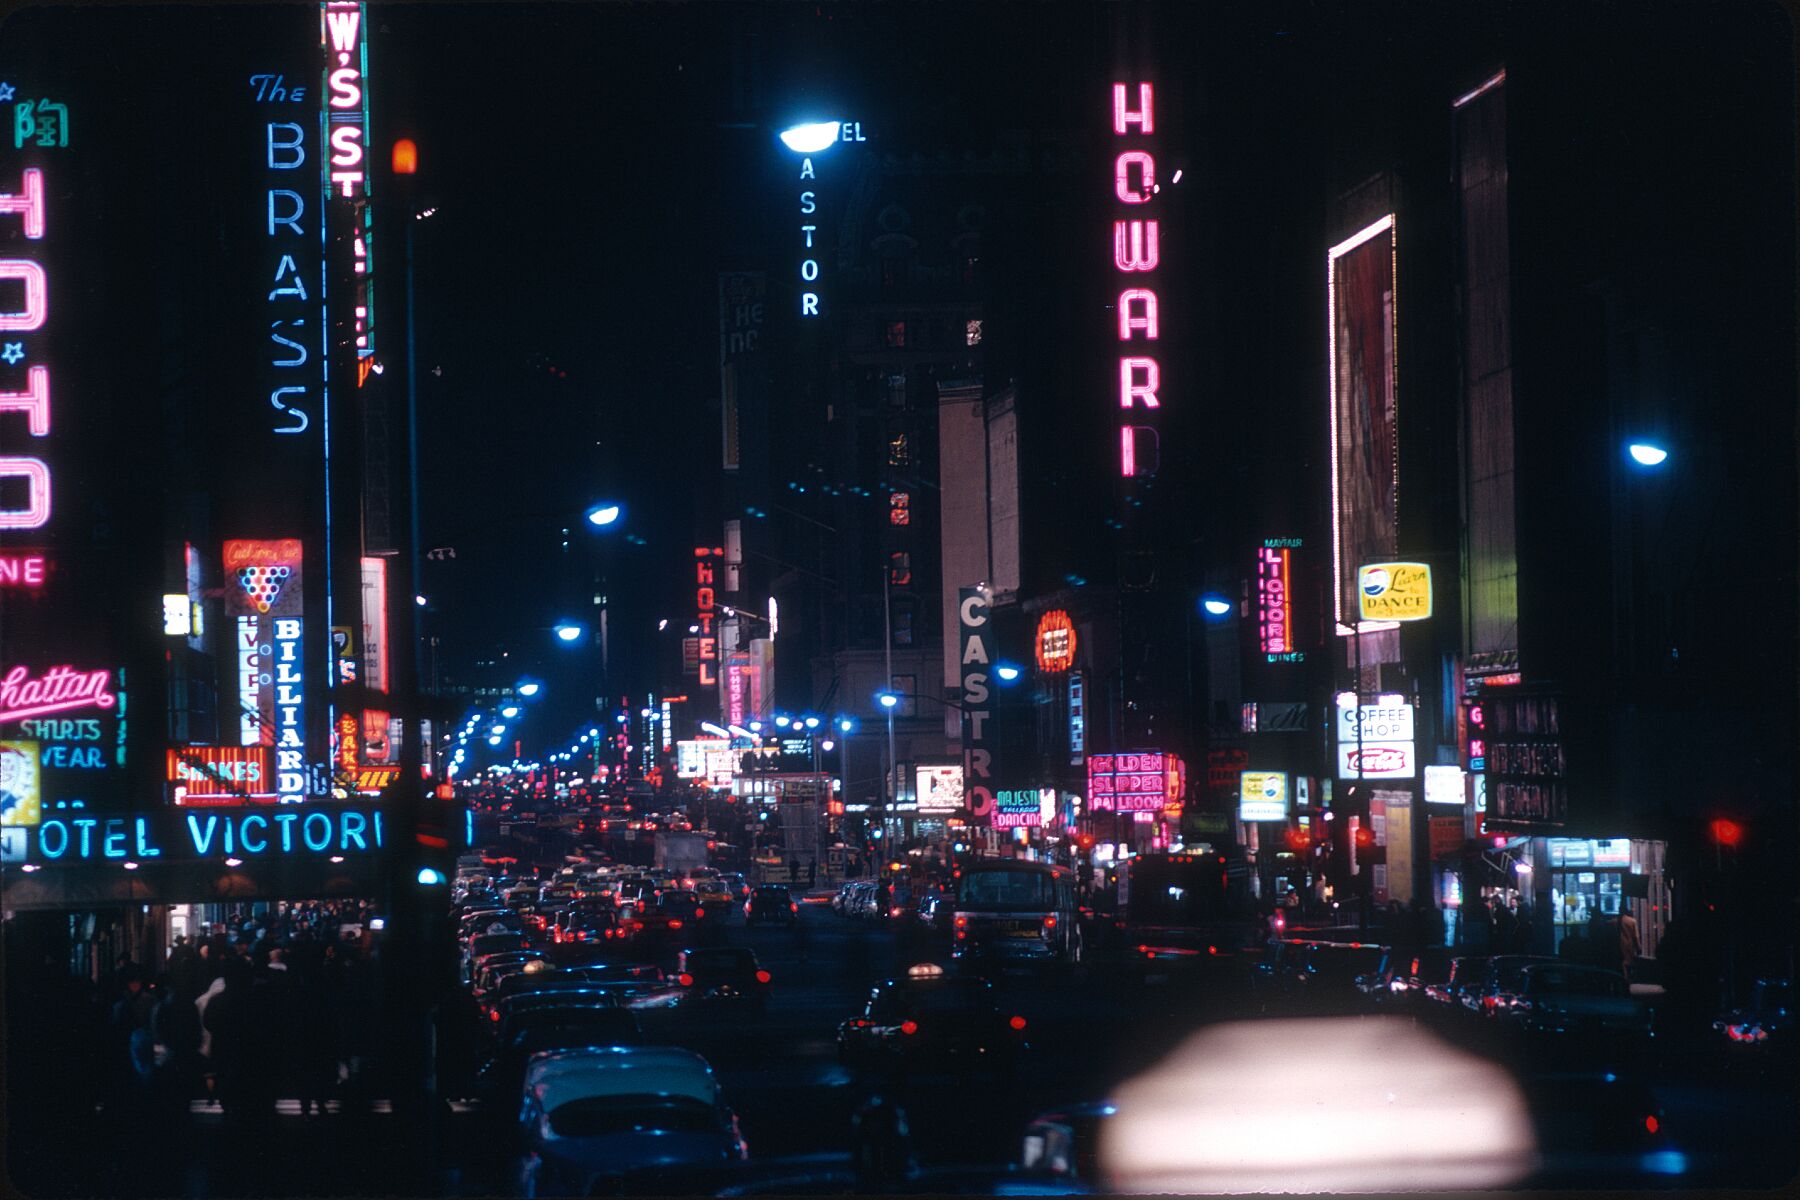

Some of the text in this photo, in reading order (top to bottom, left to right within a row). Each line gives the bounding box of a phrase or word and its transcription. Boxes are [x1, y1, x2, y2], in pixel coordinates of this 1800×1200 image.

[249, 74, 307, 102] The
[800, 158, 818, 315] ASTOR
[266, 122, 309, 434] BRASS
[1112, 81, 1161, 477] HOWARD
[1264, 548, 1285, 653] LIQUORS
[1367, 597, 1425, 608] DANCE
[696, 562, 716, 685] HOTEL
[1267, 653, 1304, 664] WINES
[960, 595, 992, 816] CASTRO
[1344, 708, 1406, 722] COFFEE
[19, 719, 101, 740] SHIRTS
[1351, 725, 1400, 737] SHOP
[1093, 755, 1163, 772] GOLDEN
[1094, 775, 1164, 793] SLIPPER
[997, 790, 1042, 807] MAJESTI
[40, 817, 160, 858] OTEL
[187, 811, 383, 857] VICTORI
